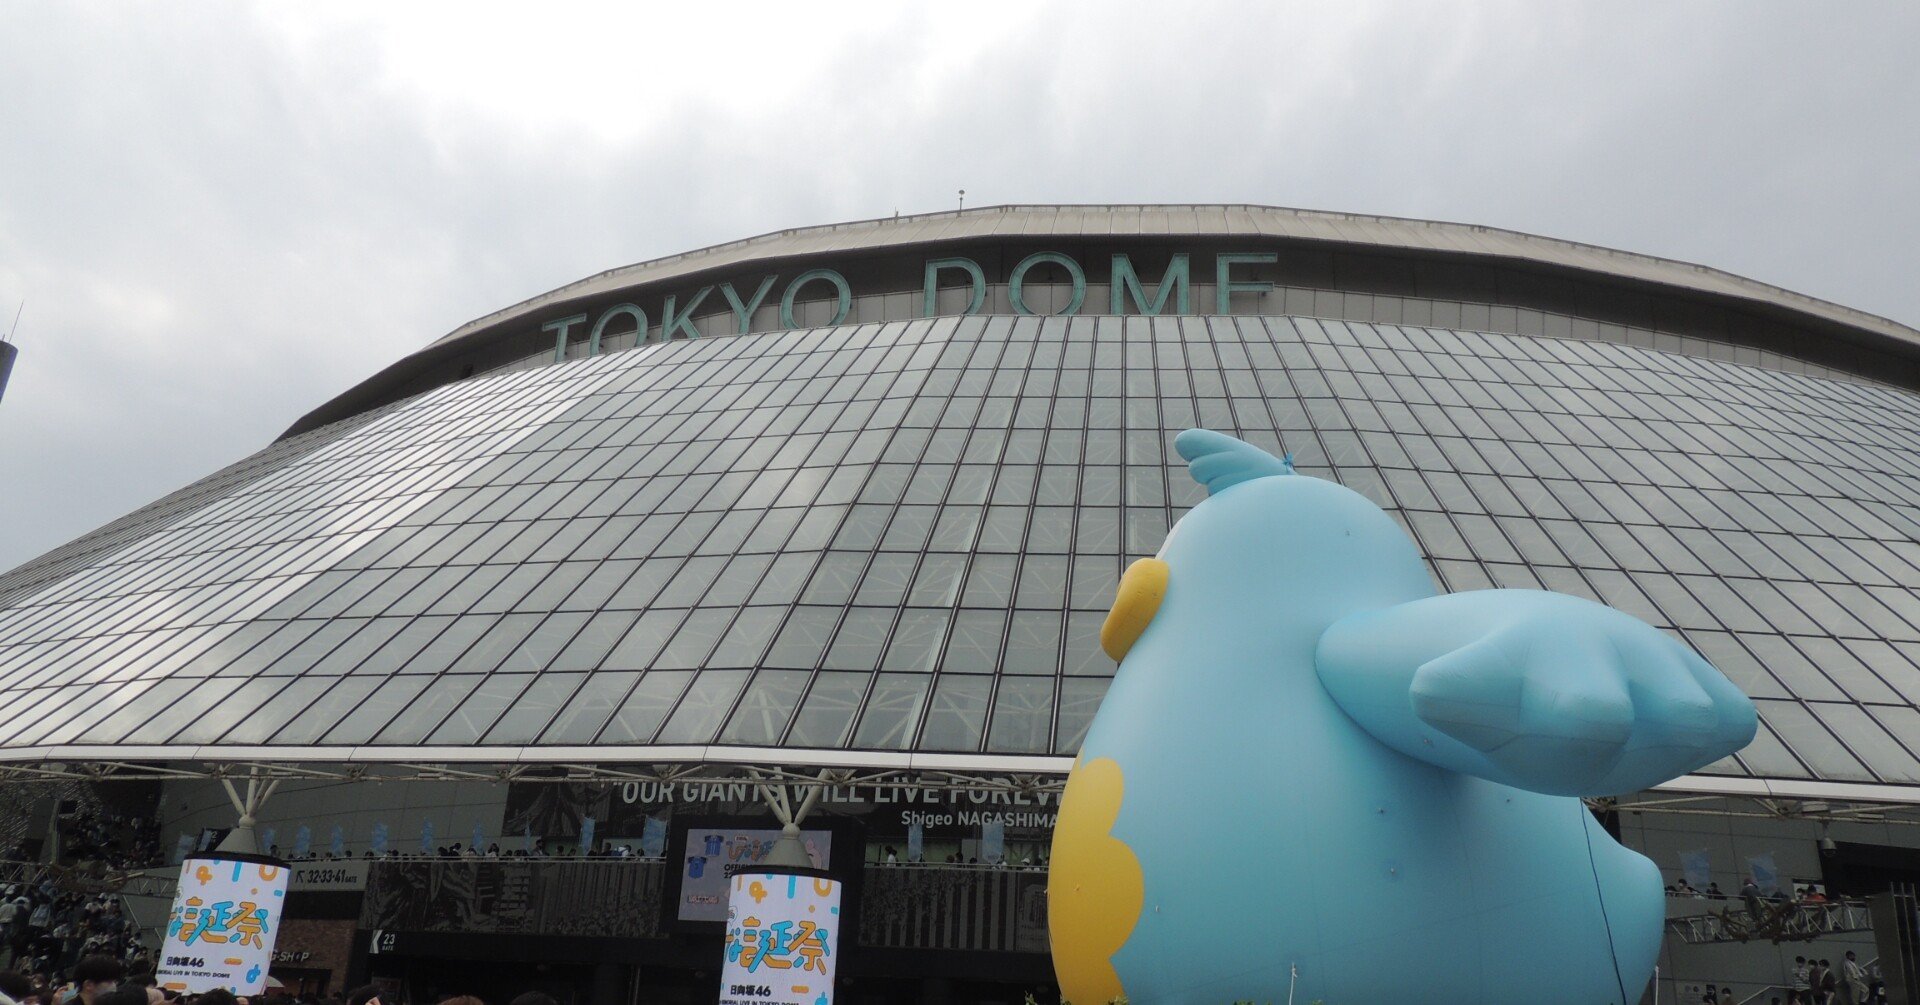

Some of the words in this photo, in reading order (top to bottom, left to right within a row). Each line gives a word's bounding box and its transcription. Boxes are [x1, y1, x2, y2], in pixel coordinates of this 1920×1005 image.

[542, 268, 851, 363] TOKYO
[682, 776, 781, 803] GIANTS
[873, 776, 940, 804] LIVE
[900, 810, 953, 829] Shigeo
[957, 811, 1057, 829] NAGASHIMA
[383, 933, 395, 945] 23
[166, 956, 205, 968] 日向坂46
[730, 984, 771, 997] 日向坂46
